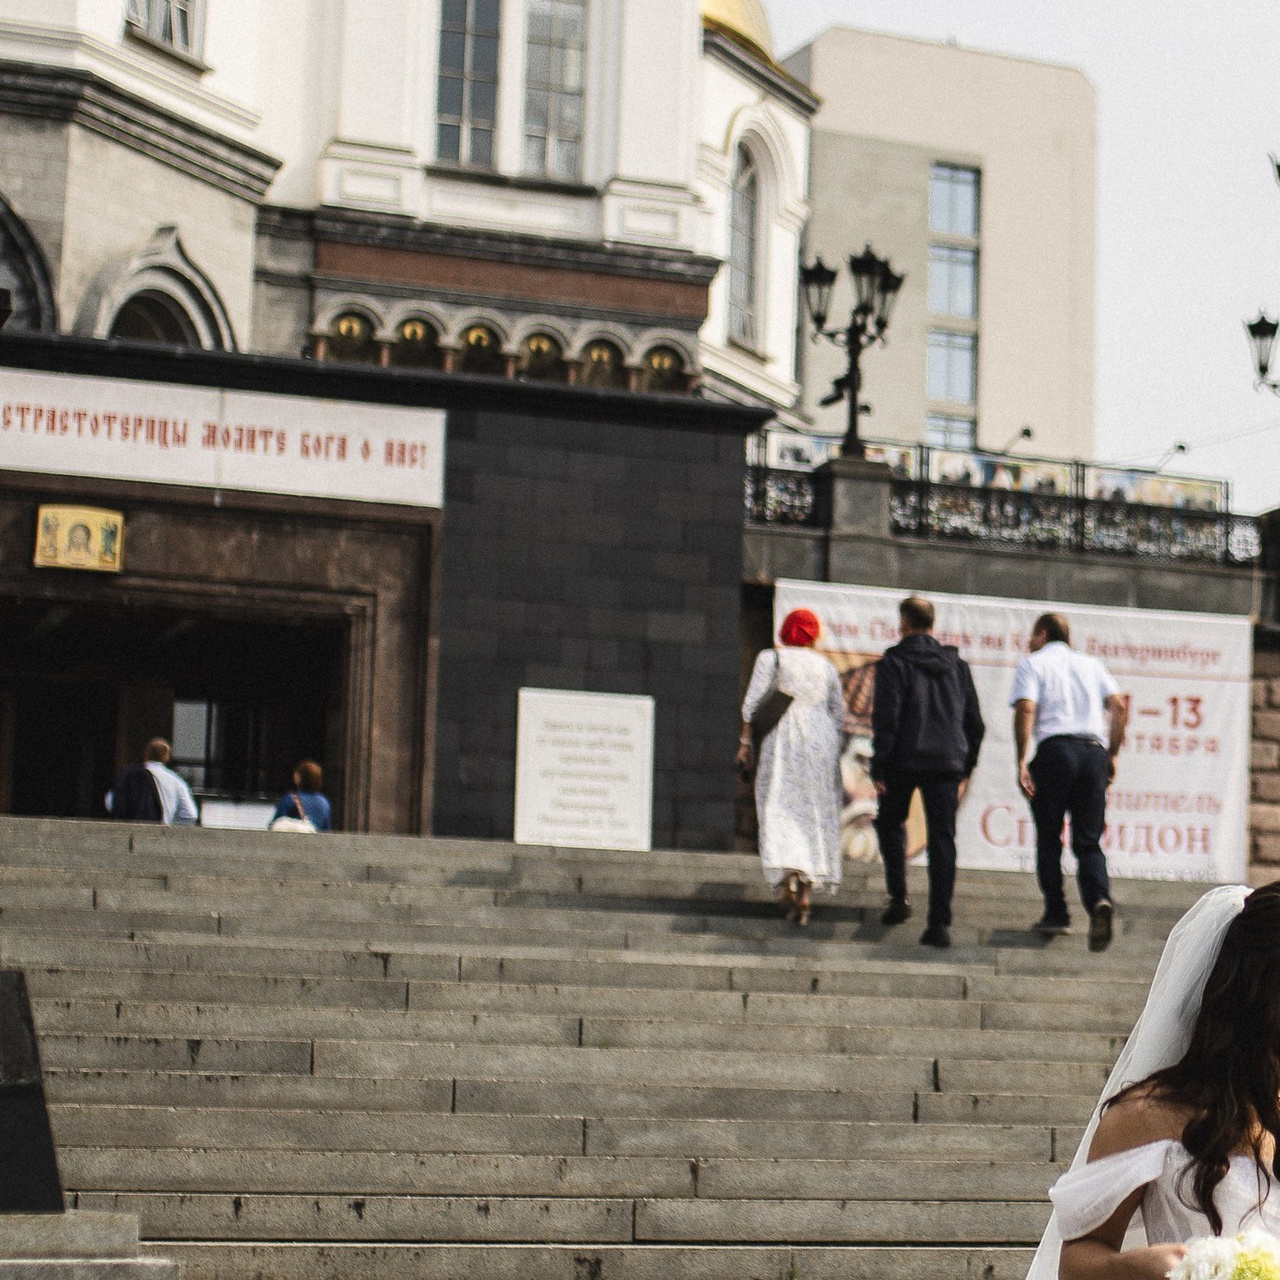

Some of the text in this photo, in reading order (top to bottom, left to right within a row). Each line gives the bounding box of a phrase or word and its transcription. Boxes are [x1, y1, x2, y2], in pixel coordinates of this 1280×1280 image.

[3, 404, 188, 448] СТРАСТОТЕРПЦЫ
[202, 423, 286, 455] МОЛИТЕ
[300, 433, 348, 462] БОГА
[360, 440, 371, 461] О
